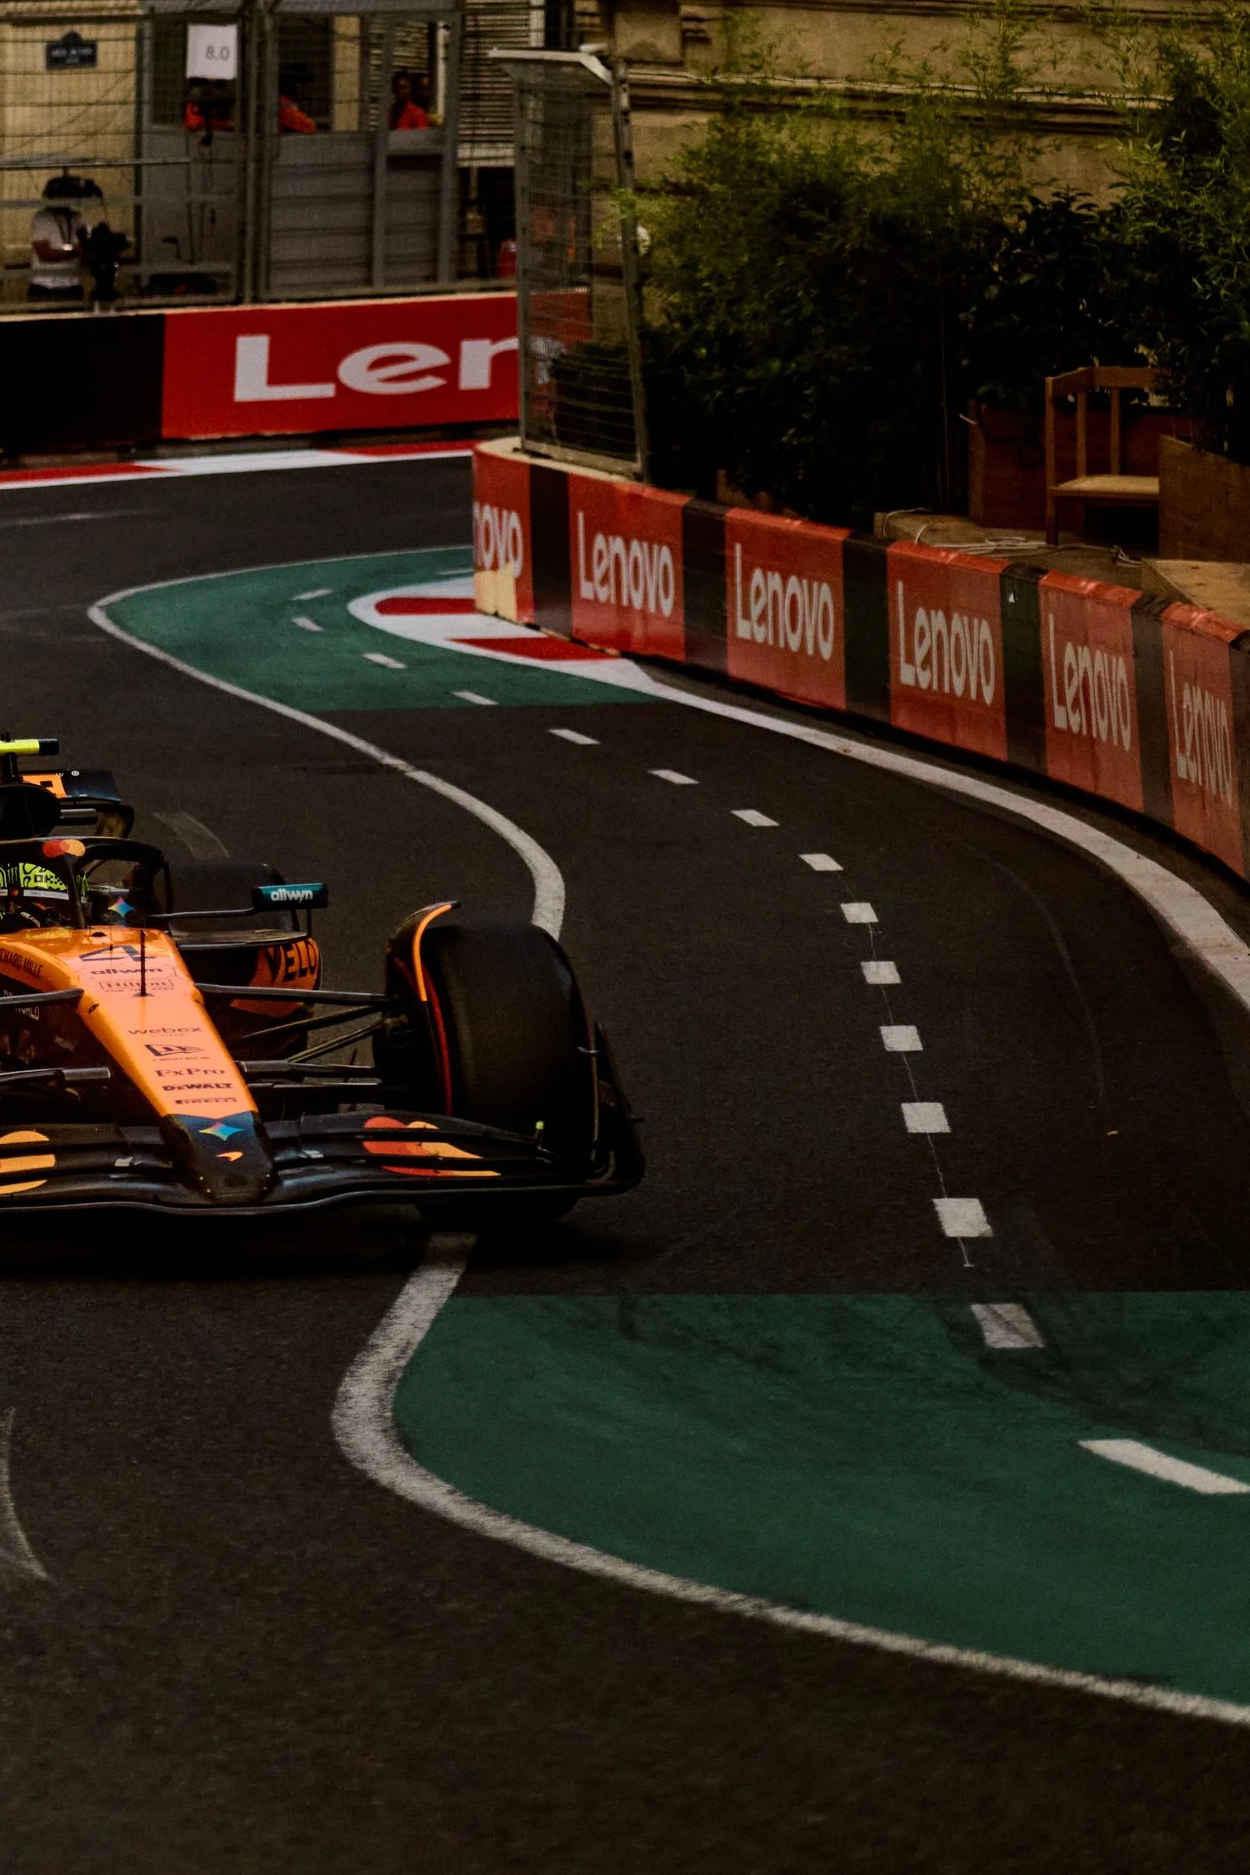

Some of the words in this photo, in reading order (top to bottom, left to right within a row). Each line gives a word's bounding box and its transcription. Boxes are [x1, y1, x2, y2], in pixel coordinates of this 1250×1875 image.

[205, 46, 230, 61] 8.0
[577, 511, 675, 616] Lenovo
[733, 542, 835, 661] Lenovo
[897, 580, 995, 706] Lenovo
[1048, 612, 1132, 752] Lenovo
[1168, 650, 1233, 809] Lenovo
[270, 888, 314, 903] allwyn
[24, 958, 44, 977] MILLE
[127, 1027, 202, 1035] webex
[154, 1068, 225, 1077] FxPro
